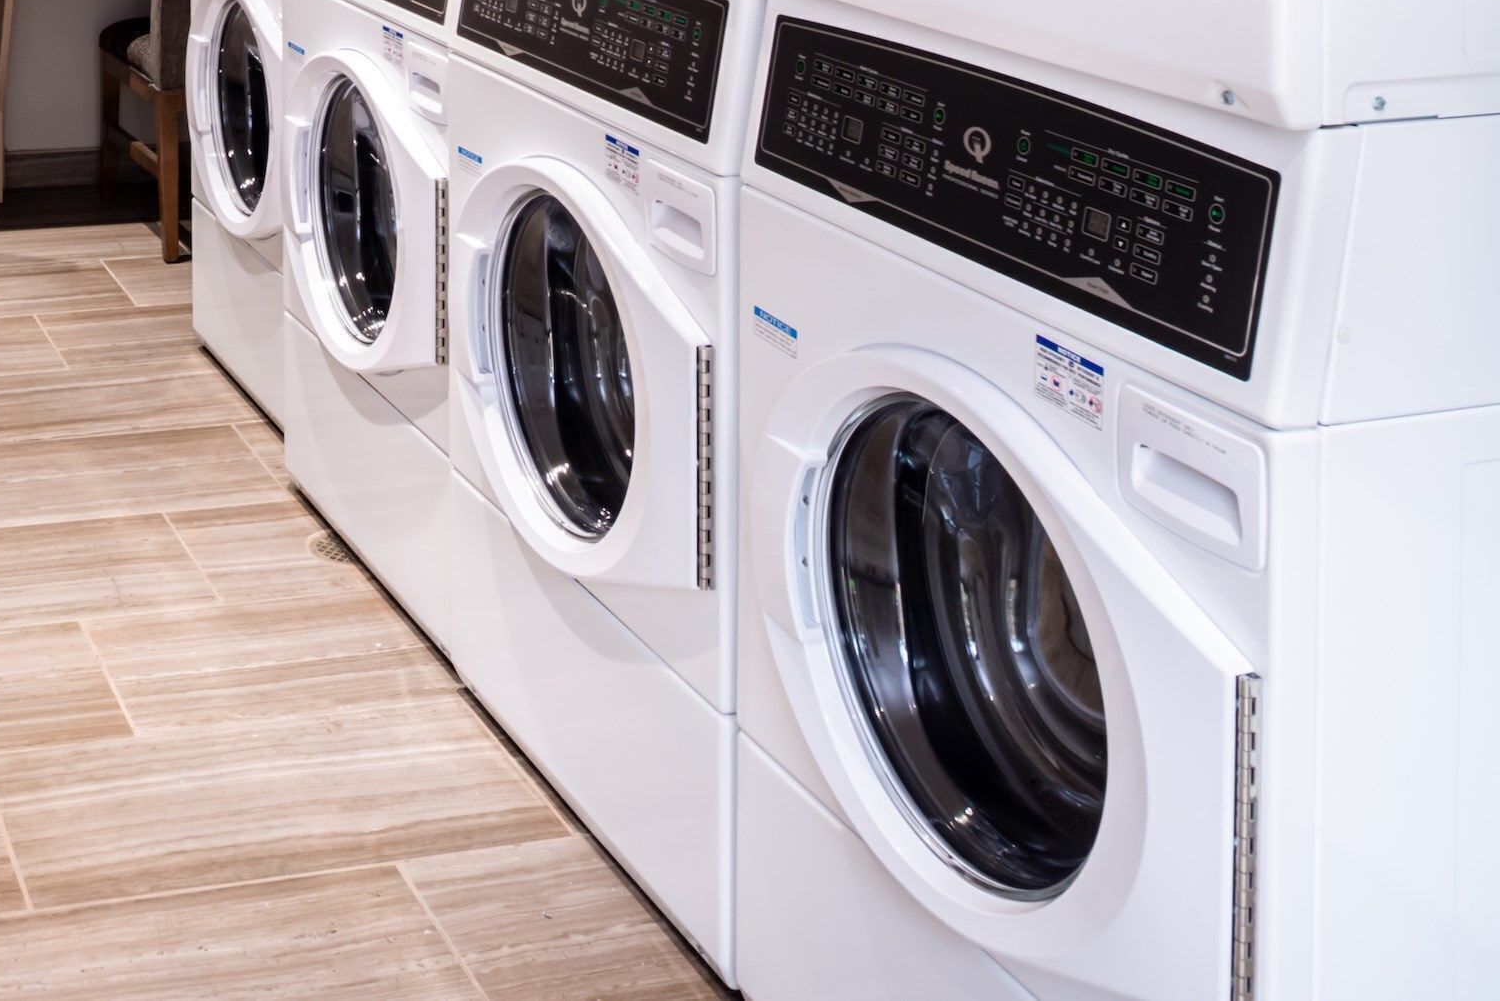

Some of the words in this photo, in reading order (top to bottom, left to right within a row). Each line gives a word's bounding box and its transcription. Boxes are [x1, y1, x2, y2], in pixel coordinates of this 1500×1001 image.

[943, 159, 972, 179] Speed
[760, 310, 792, 335] NOTICE
[1057, 346, 1081, 363] NOTICE
